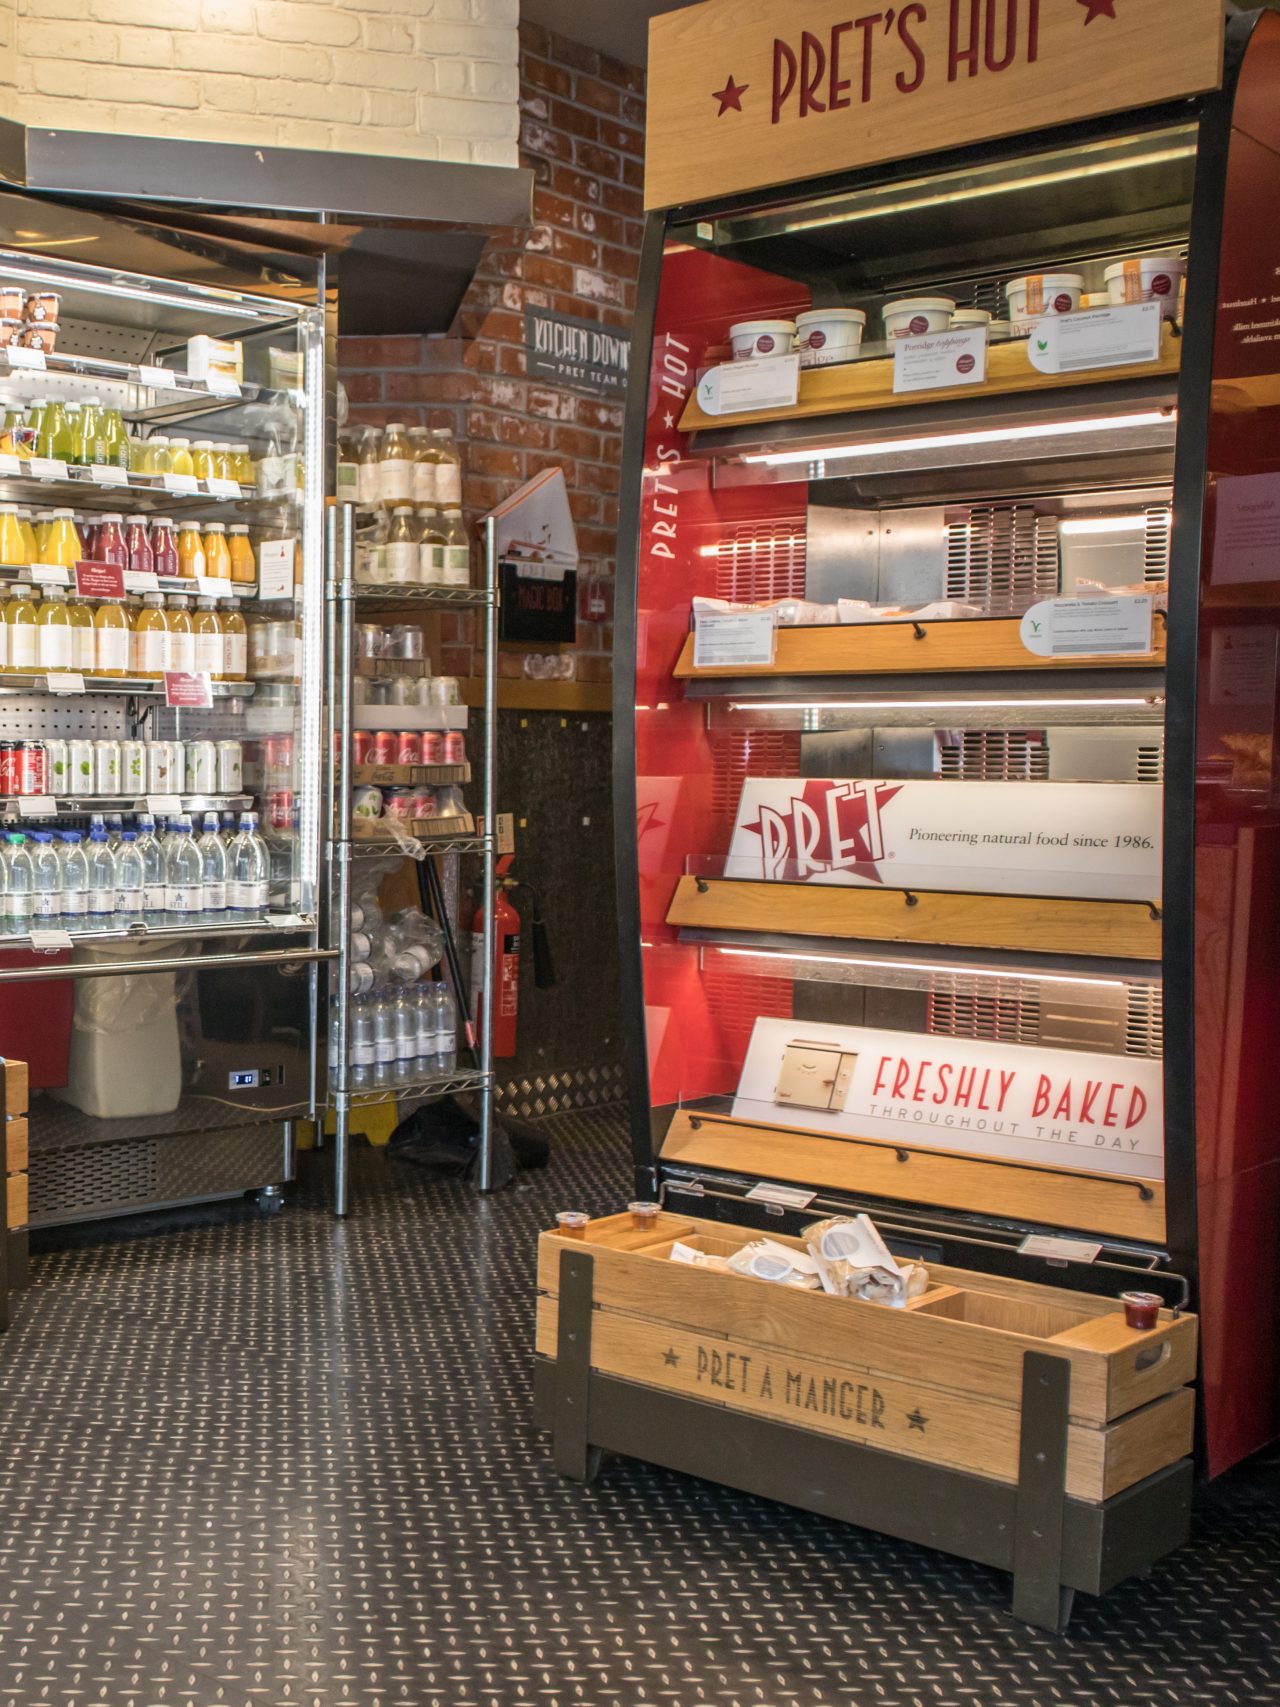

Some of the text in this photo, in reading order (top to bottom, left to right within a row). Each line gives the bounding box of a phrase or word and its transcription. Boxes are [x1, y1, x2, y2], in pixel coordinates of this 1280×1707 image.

[772, 3, 927, 124] PRET'S
[534, 317, 588, 361] KITCHEN
[661, 332, 690, 399] HOT
[904, 340, 934, 352] Porridge
[590, 371, 617, 385] TEAM
[759, 781, 888, 880] PRET
[909, 828, 1154, 849] Pioneering natural food since 1986.
[873, 1056, 1147, 1129] FRESHLY BAKED
[870, 1104, 1140, 1151] THROUGHOUT THE DAY
[697, 1345, 886, 1430] PRET A MANGER
